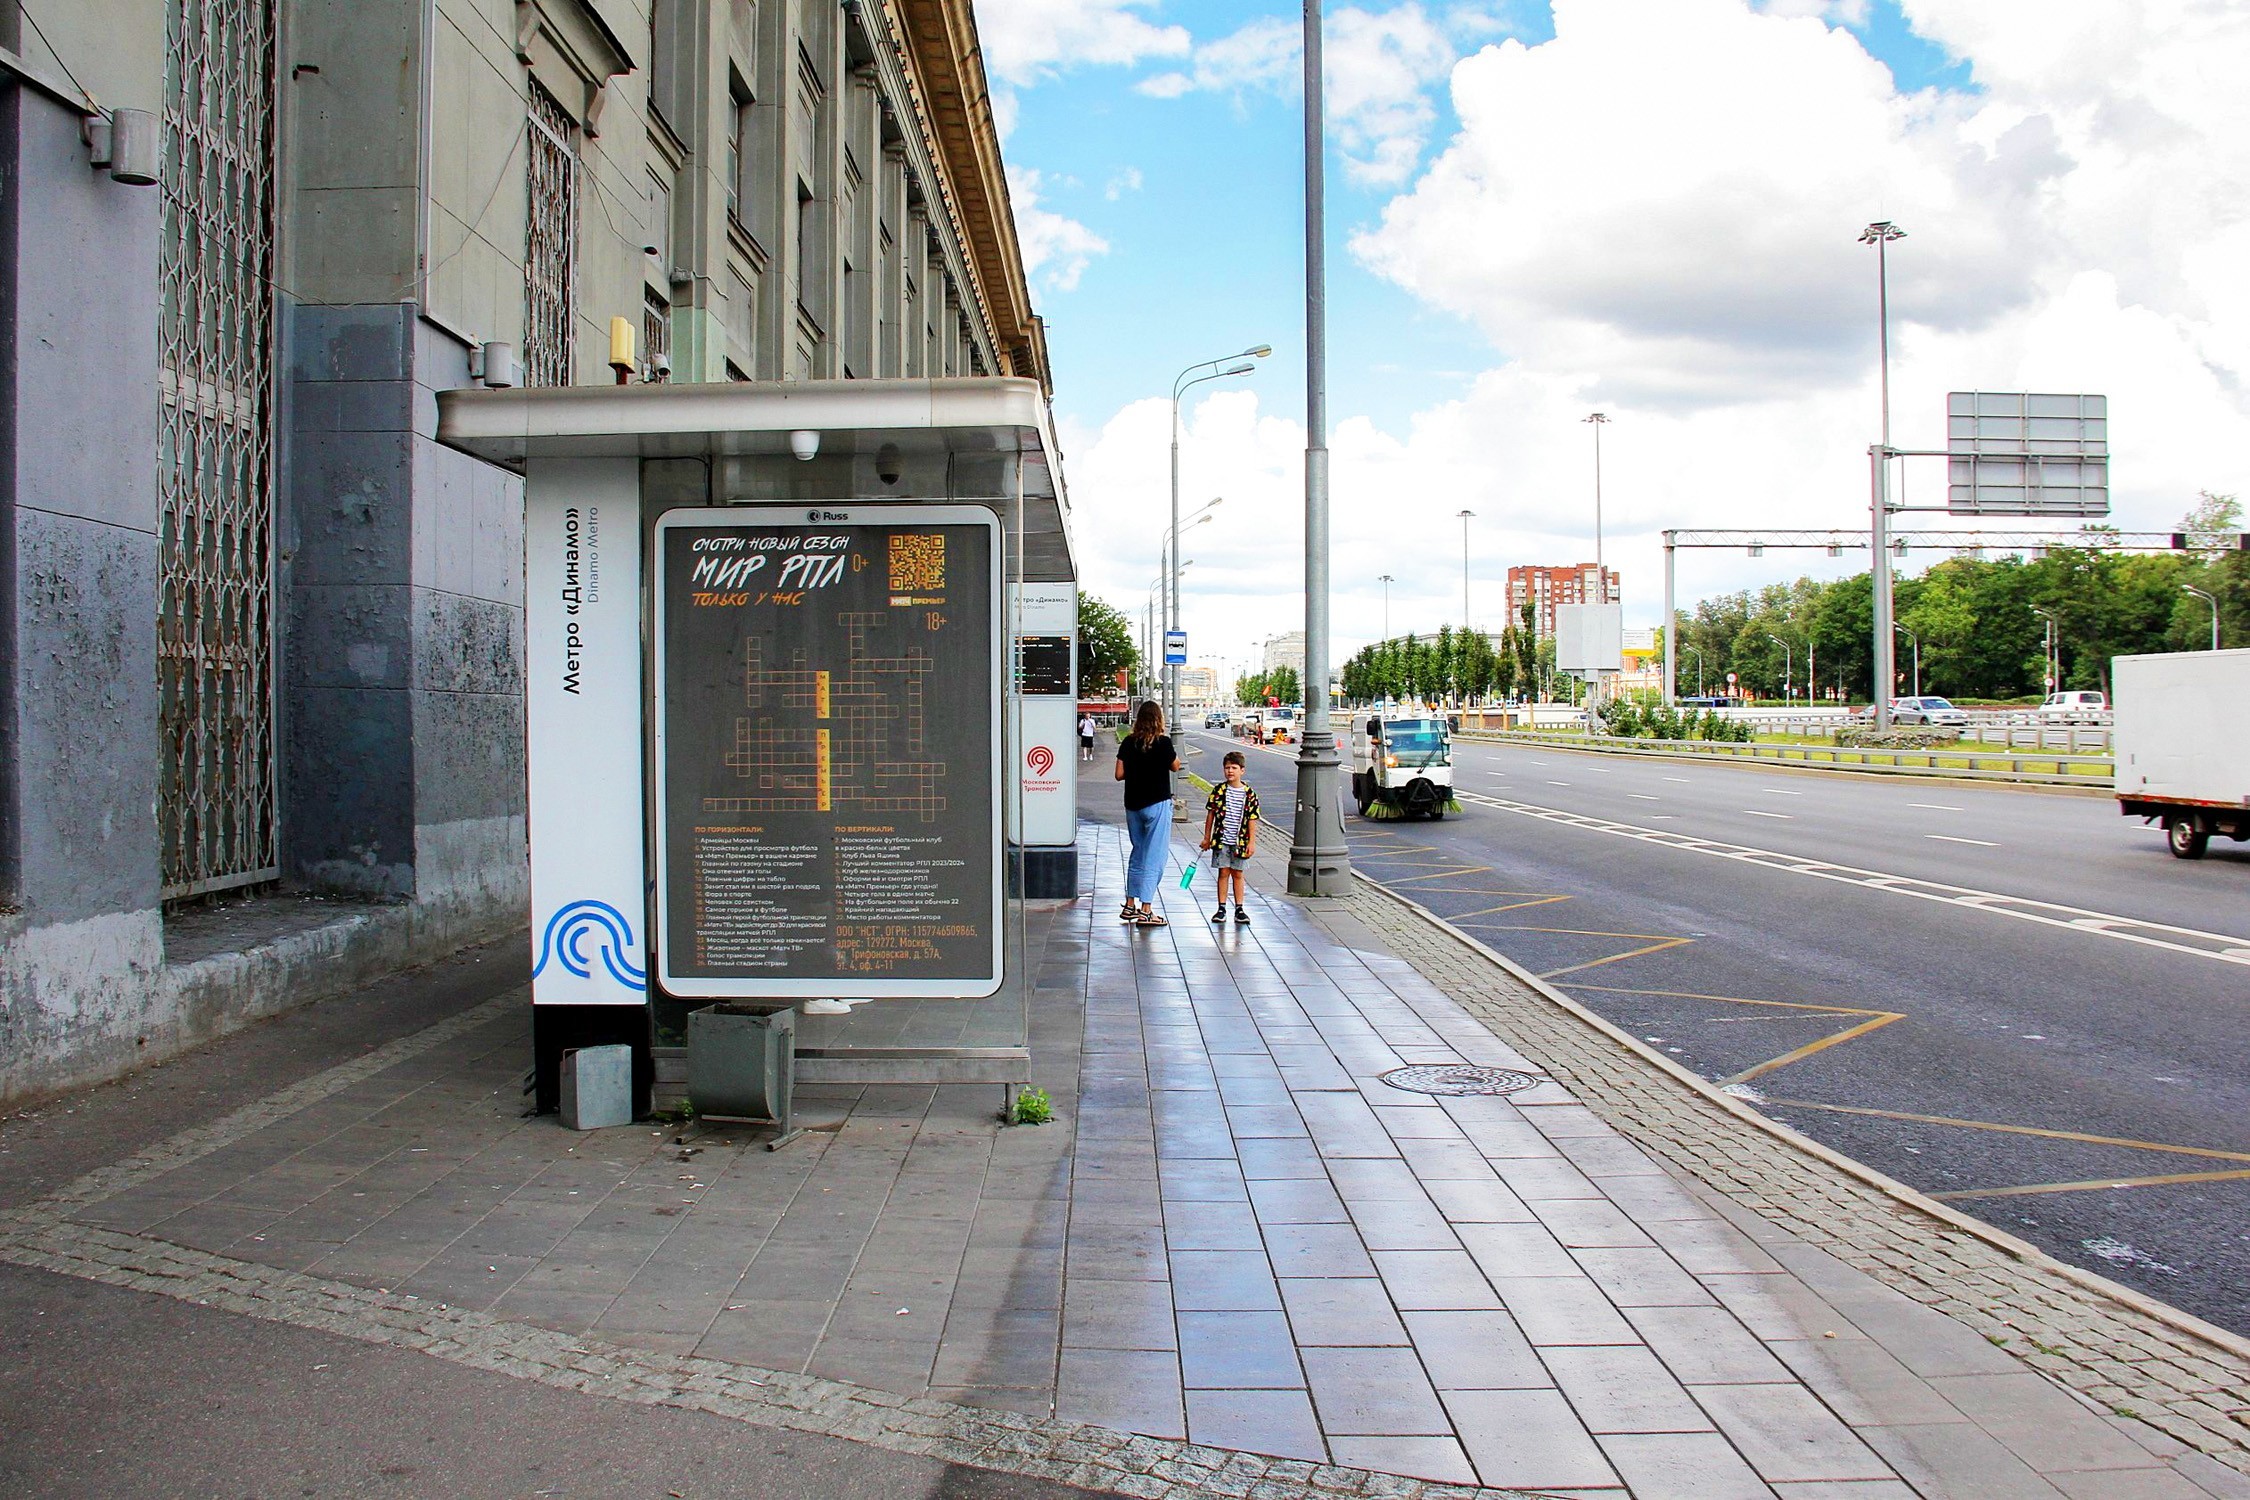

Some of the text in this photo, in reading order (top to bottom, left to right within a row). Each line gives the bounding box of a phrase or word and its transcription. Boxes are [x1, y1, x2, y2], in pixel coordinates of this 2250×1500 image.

[823, 512, 848, 521] Russ
[692, 536, 850, 551] СМОТРИ НОВЫЙ СЕЗОН
[587, 507, 598, 604] Dinamo Metro
[853, 553, 869, 572] 0+
[692, 554, 846, 590] МИР РПЛ
[562, 507, 583, 695] Метро «Динамо»
[692, 592, 805, 606] ТОЛЬКО У НАС
[1035, 596, 1068, 604] «Динамо»
[926, 611, 947, 631] 18+
[1024, 785, 1058, 793] Транспорт
[836, 925, 853, 937] ООО
[885, 925, 910, 937] ОГРН:
[836, 939, 864, 949] адрес:
